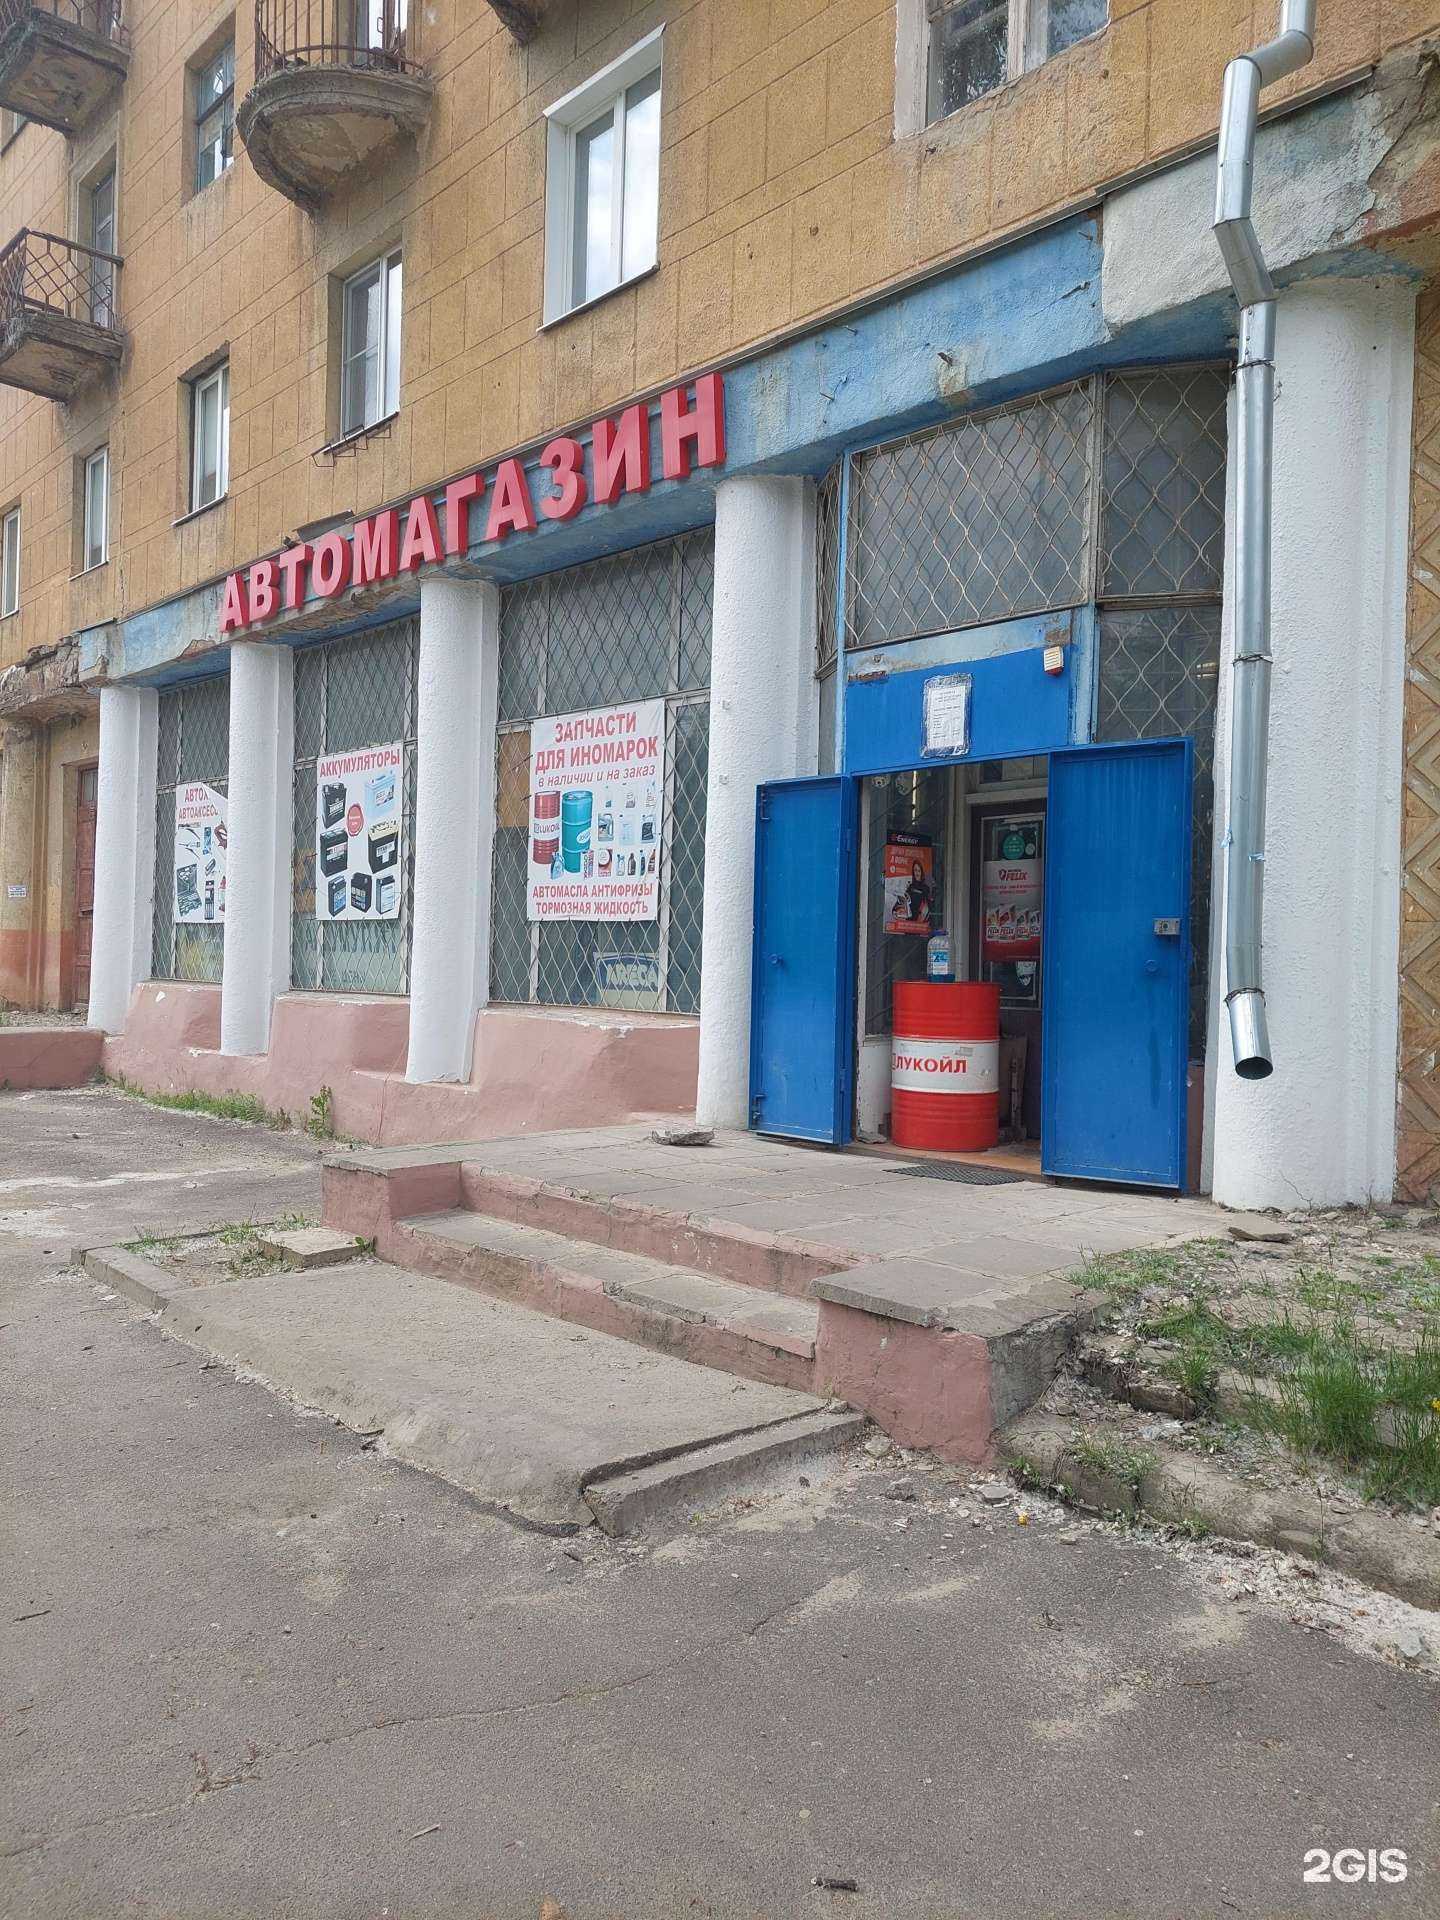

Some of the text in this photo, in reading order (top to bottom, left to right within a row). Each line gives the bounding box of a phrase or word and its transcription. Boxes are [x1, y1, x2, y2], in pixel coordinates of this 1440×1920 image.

[219, 372, 726, 632] АВТОМАГАЗИН
[555, 711, 637, 743] ЗАПЧАСТИ
[320, 748, 400, 778] АККУМУЛЯТОРЫ
[535, 736, 658, 775] ДЛЯ ИНОМАРОК
[538, 764, 656, 787] в наличии и на заказ
[533, 883, 653, 899] АВТОМАСЛА АНТИФРИЗЫ
[536, 901, 648, 917] ТОРМОЗНАЯ ЖИДКОСТЬ
[896, 1056, 967, 1074] ЛУКОЙЛ
